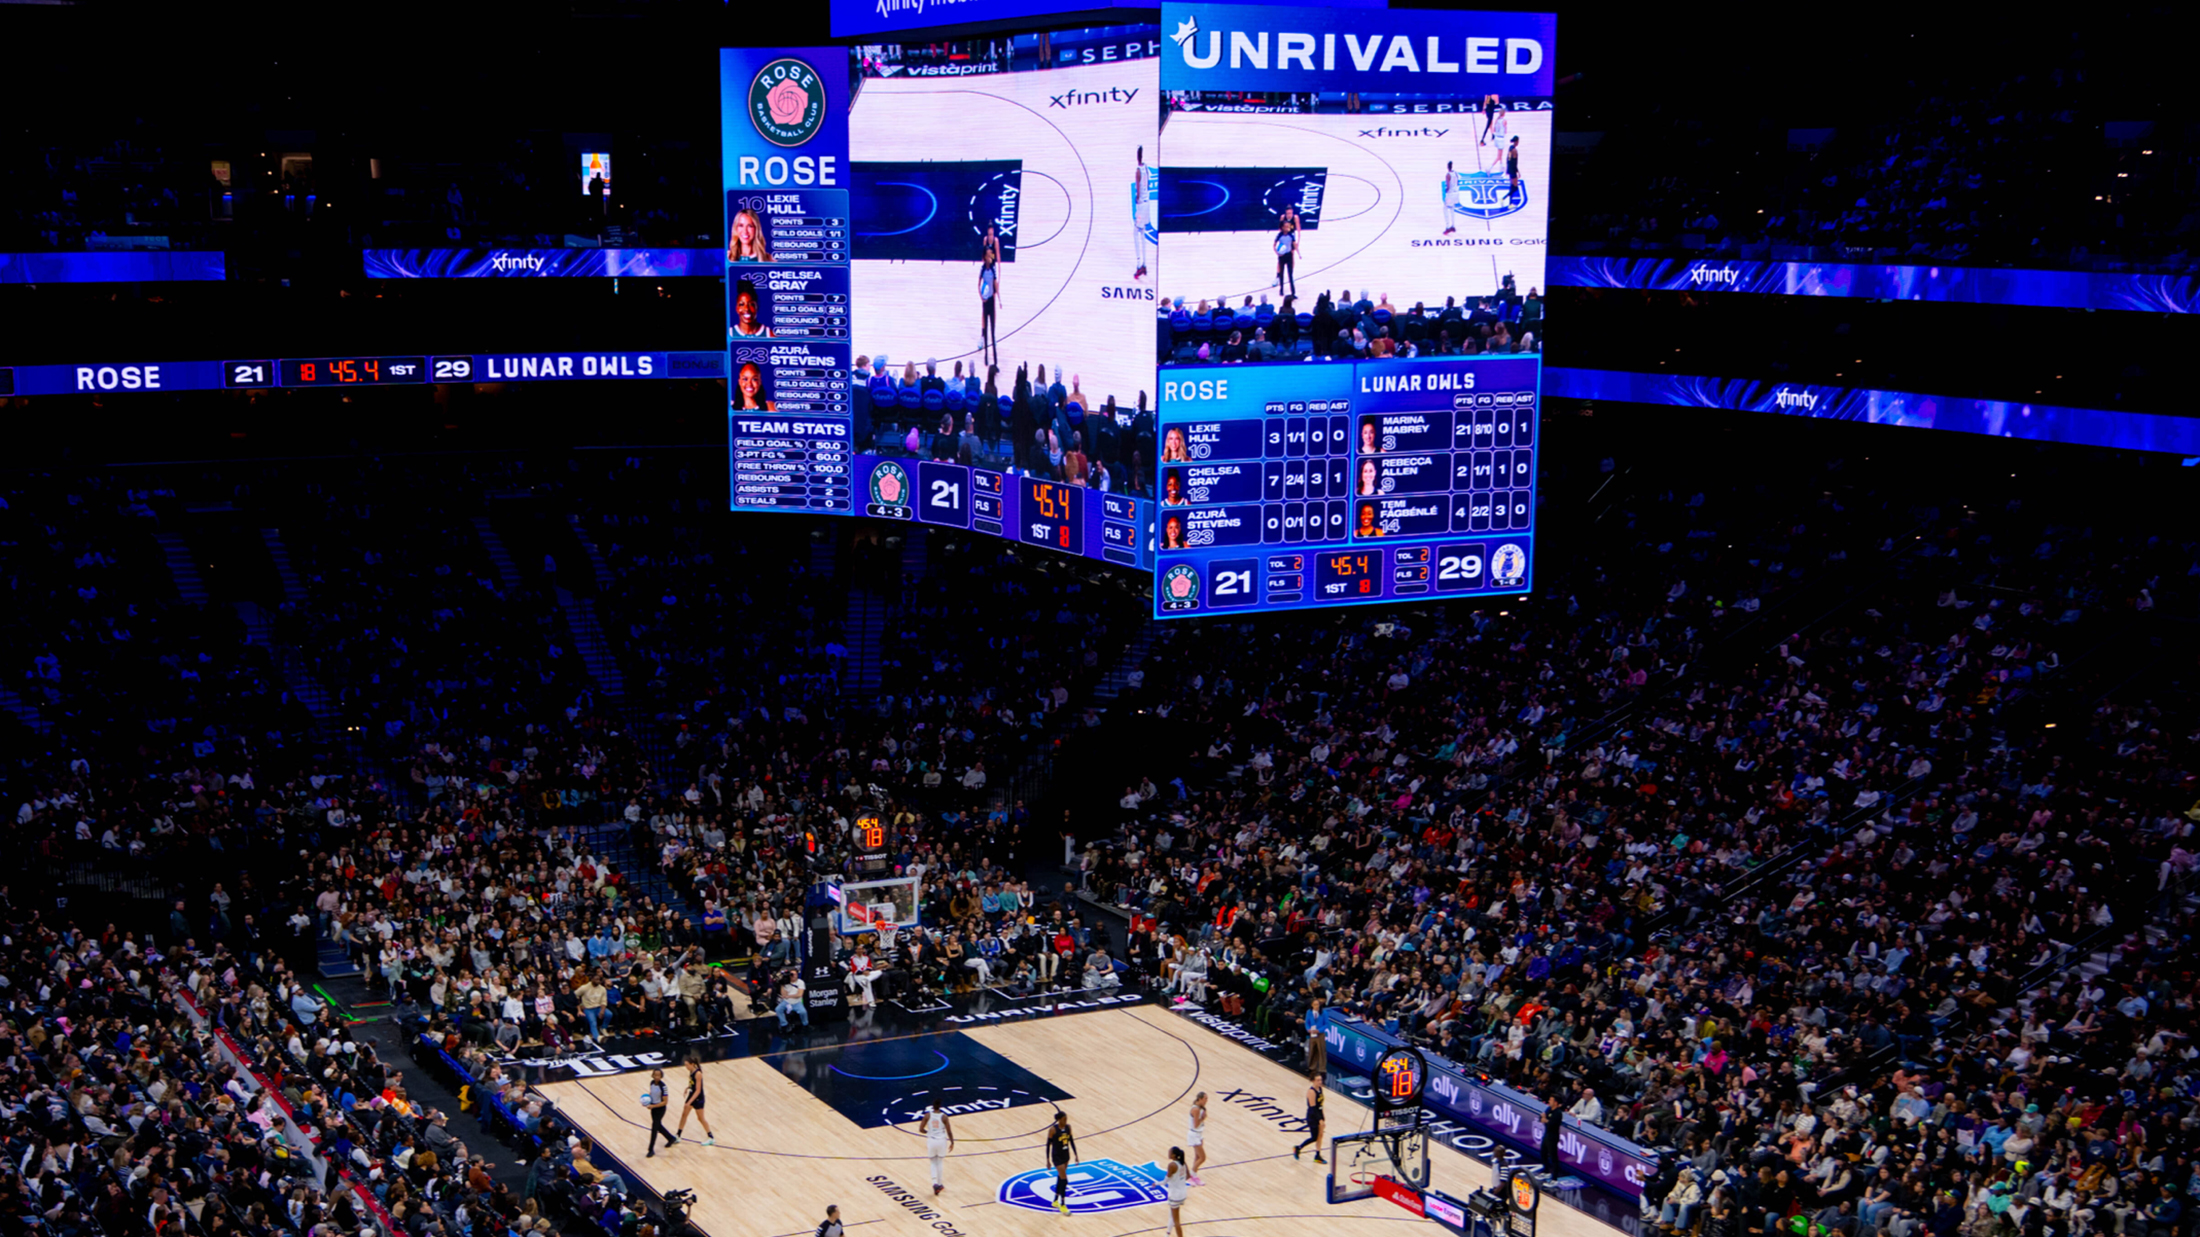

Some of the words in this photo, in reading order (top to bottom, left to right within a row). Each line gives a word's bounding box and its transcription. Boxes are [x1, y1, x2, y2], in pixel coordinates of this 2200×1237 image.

[1182, 31, 1544, 74] UNRIVALED
[760, 66, 814, 89] ROSE
[1049, 87, 1140, 109] xfinity
[757, 103, 804, 137] BASKETBALL
[1358, 127, 1450, 138] xfinity
[740, 156, 836, 186] ROSE
[738, 196, 766, 214] 10
[767, 195, 800, 203] LEXIE
[767, 204, 806, 214] HULL
[995, 184, 1020, 236] xfinity
[1410, 238, 1504, 247] SAMSUNG
[492, 253, 545, 272] xfinity
[768, 271, 822, 280] CHELSEA
[1690, 264, 1739, 286] xfinity
[769, 280, 808, 290] GRAY
[1101, 286, 1154, 301] SAMS
[736, 347, 769, 364] 23
[770, 345, 810, 355] AZURÁ
[488, 357, 573, 378] LUNAR
[582, 356, 653, 376] OWLS
[770, 355, 836, 366] STEVENS
[234, 365, 263, 382] 21
[329, 360, 379, 382] 45.4
[389, 365, 416, 376] 1ST
[435, 361, 470, 378] 29
[77, 366, 160, 390] ROSE
[1362, 375, 1421, 393] LUNAR
[1427, 373, 1475, 390] OWLS
[1165, 380, 1228, 402] ROSE
[1776, 388, 1819, 411] xfinity
[1383, 416, 1425, 424] MARINA
[738, 421, 789, 433] TEAM
[792, 422, 846, 436] STATS
[1189, 424, 1221, 433] LEXIE
[1382, 425, 1430, 434] MABREY
[1456, 424, 1471, 435] 21
[1475, 423, 1493, 434] 8/10
[1498, 423, 1509, 434] 0
[1520, 422, 1527, 432] 1
[1189, 434, 1220, 443] HULL
[1269, 432, 1280, 444] 3
[1287, 432, 1305, 443] 1/1
[1311, 431, 1324, 442] 0
[1333, 430, 1345, 441] 0
[1382, 435, 1396, 450] 3
[816, 442, 841, 450] 50.0
[1189, 444, 1211, 459] 10
[816, 454, 841, 462] 60.0
[1382, 457, 1432, 467] REBECCA
[814, 465, 843, 473] 100.0
[876, 465, 903, 480] ROSE
[1188, 466, 1241, 477] CHELSEA
[1381, 467, 1418, 476] ALLEN
[1456, 466, 1467, 477] 2
[1474, 465, 1491, 476] 1/1
[1499, 464, 1505, 474] 1
[1516, 463, 1528, 474] 0
[975, 475, 990, 487] TOL
[1188, 477, 1220, 486] GRAY
[1268, 476, 1280, 486] 7
[1286, 474, 1304, 486] 2/4
[1311, 473, 1322, 484] 3
[1381, 477, 1395, 492] 9
[931, 480, 959, 509] 21
[1033, 484, 1069, 520] 45.4
[1187, 487, 1209, 503] 12
[975, 500, 990, 511] FLS
[1105, 501, 1122, 513] TOL
[1128, 502, 1134, 518] 2
[1380, 500, 1406, 509] TEMI
[1455, 507, 1465, 518] 4
[1472, 506, 1489, 517] 2/2
[1495, 505, 1505, 516] 3
[1515, 504, 1526, 515] 0
[1187, 508, 1226, 520] AZURÁ
[1267, 518, 1279, 529] 0
[1285, 517, 1303, 528] 0/1
[1309, 515, 1321, 527] 0
[1331, 514, 1342, 526] 0
[1031, 524, 1051, 540] 1ST
[1187, 519, 1241, 530] STEVENS
[1380, 519, 1400, 533] 14
[1105, 527, 1121, 540] FLS
[1128, 529, 1134, 545] 2
[1187, 529, 1214, 545] 23
[1420, 549, 1428, 561] 2
[1294, 557, 1301, 569] 2
[1331, 555, 1368, 575] 45.4
[1439, 555, 1482, 580] 29
[1168, 568, 1194, 580] ROSE
[1420, 567, 1427, 579] 2
[1215, 570, 1251, 595] 21
[1325, 583, 1348, 593] 1ST
[866, 827, 883, 848] 18
[809, 988, 838, 999] Morgan
[810, 998, 838, 1007] Stanley
[946, 994, 1142, 1022] UNRIVALED
[1324, 1025, 1346, 1053] ally
[567, 1052, 669, 1077] Lite
[1382, 1058, 1408, 1073] 45.4
[1392, 1070, 1413, 1097] 18
[1432, 1075, 1459, 1105] ally
[1391, 1106, 1420, 1116] TISSOT
[1492, 1102, 1521, 1134] ally
[1557, 1132, 1587, 1164] ally
[1098, 1161, 1166, 1200] UNRIVALED
[866, 1175, 941, 1221] SAMSUNG
